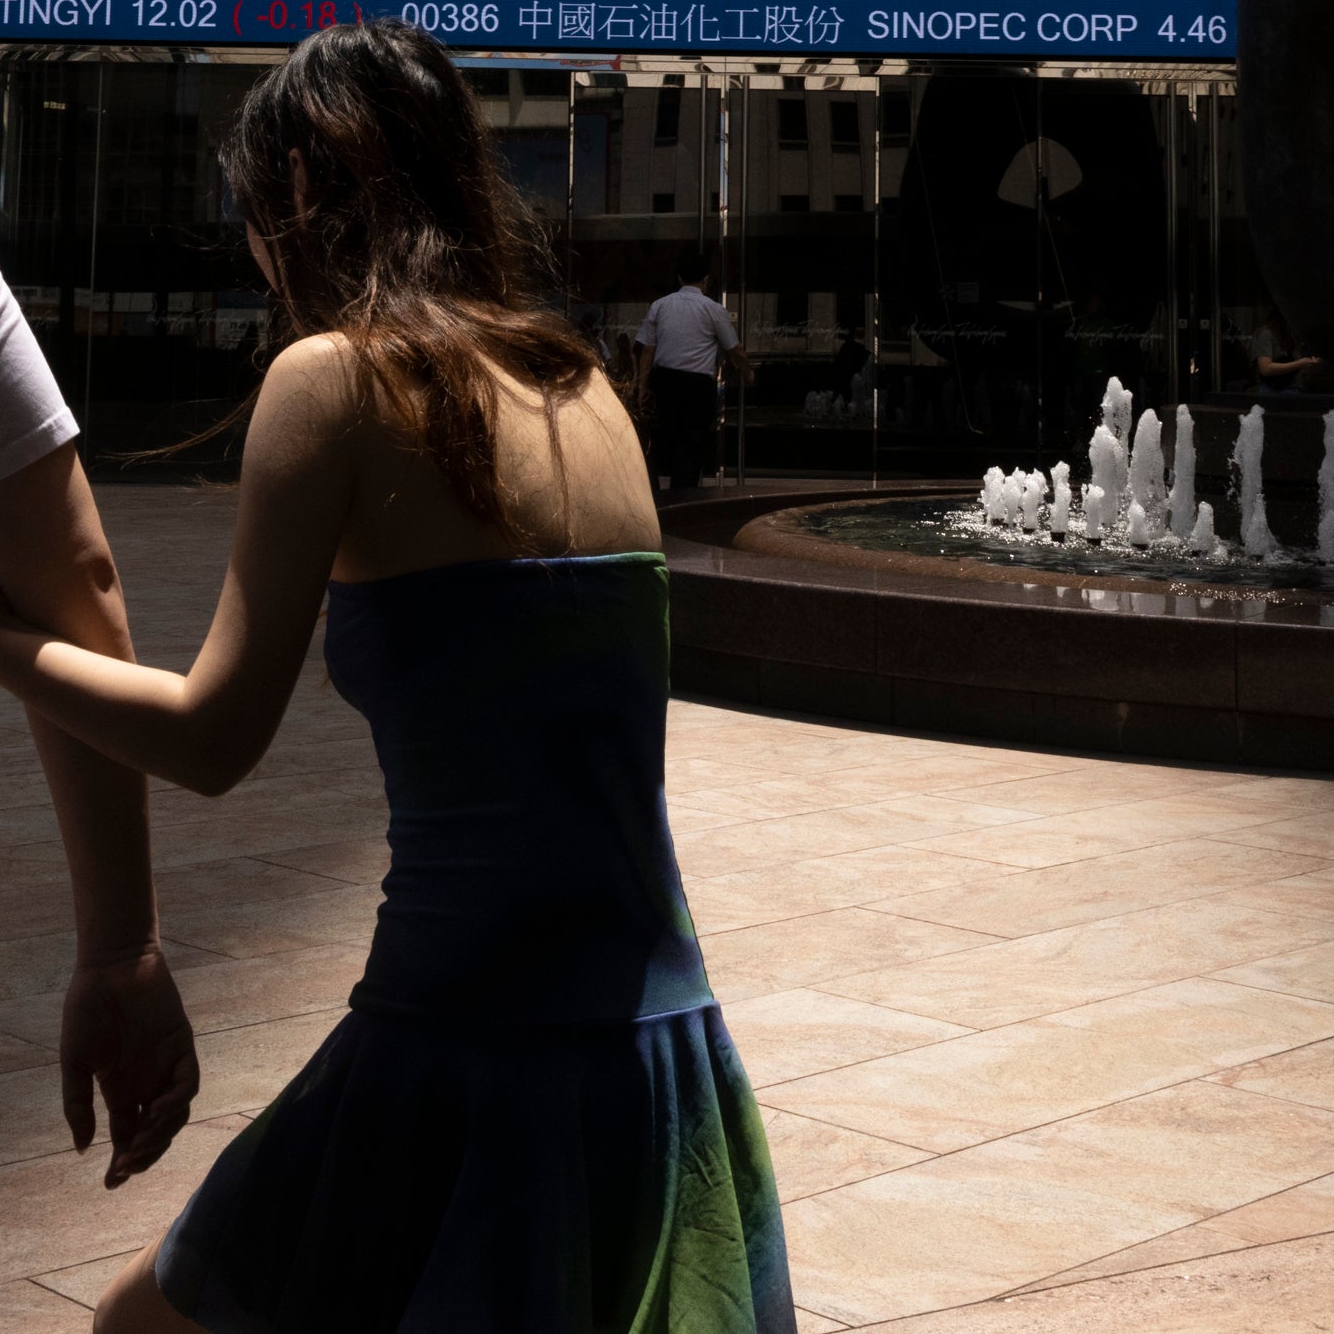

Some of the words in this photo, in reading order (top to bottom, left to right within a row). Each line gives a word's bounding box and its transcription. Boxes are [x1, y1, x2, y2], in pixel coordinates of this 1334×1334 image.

[133, 0, 216, 27] 12.02
[400, 3, 499, 35] 00386
[519, 1, 844, 44] 中國石油化工股份
[868, 11, 1026, 40] SINOPEC
[1037, 13, 1137, 41] CORP
[1158, 15, 1226, 43] 4.46
